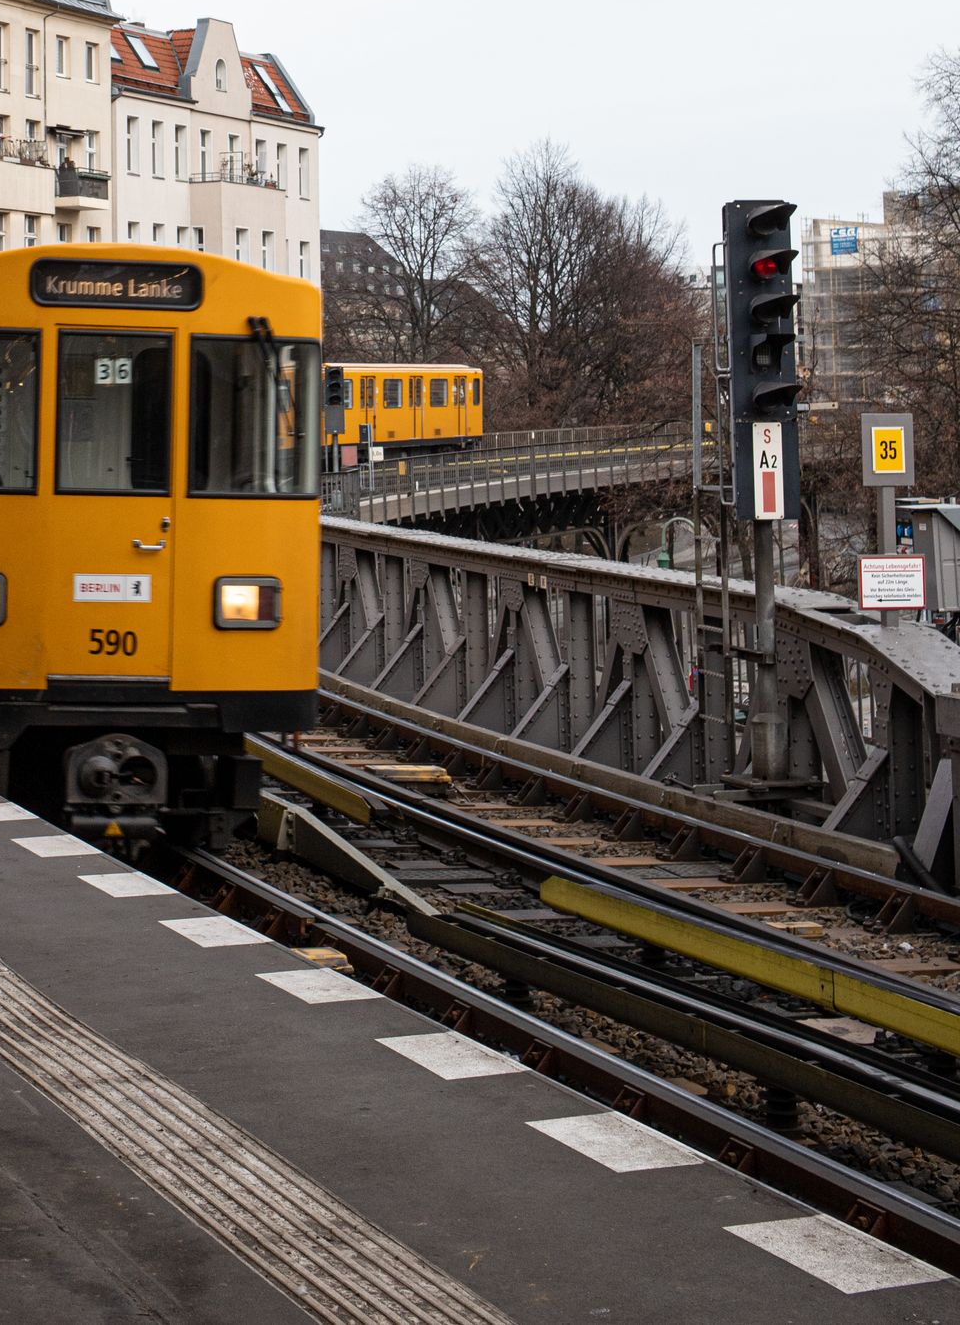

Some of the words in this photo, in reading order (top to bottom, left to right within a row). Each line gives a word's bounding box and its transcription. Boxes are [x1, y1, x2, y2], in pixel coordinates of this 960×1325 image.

[45, 275, 123, 297] Krumme
[127, 278, 183, 299] Lanke
[99, 363, 129, 380] 36
[763, 429, 771, 444] S
[880, 440, 897, 460] 35
[79, 583, 120, 593] BERLIN
[88, 628, 138, 657] 590
